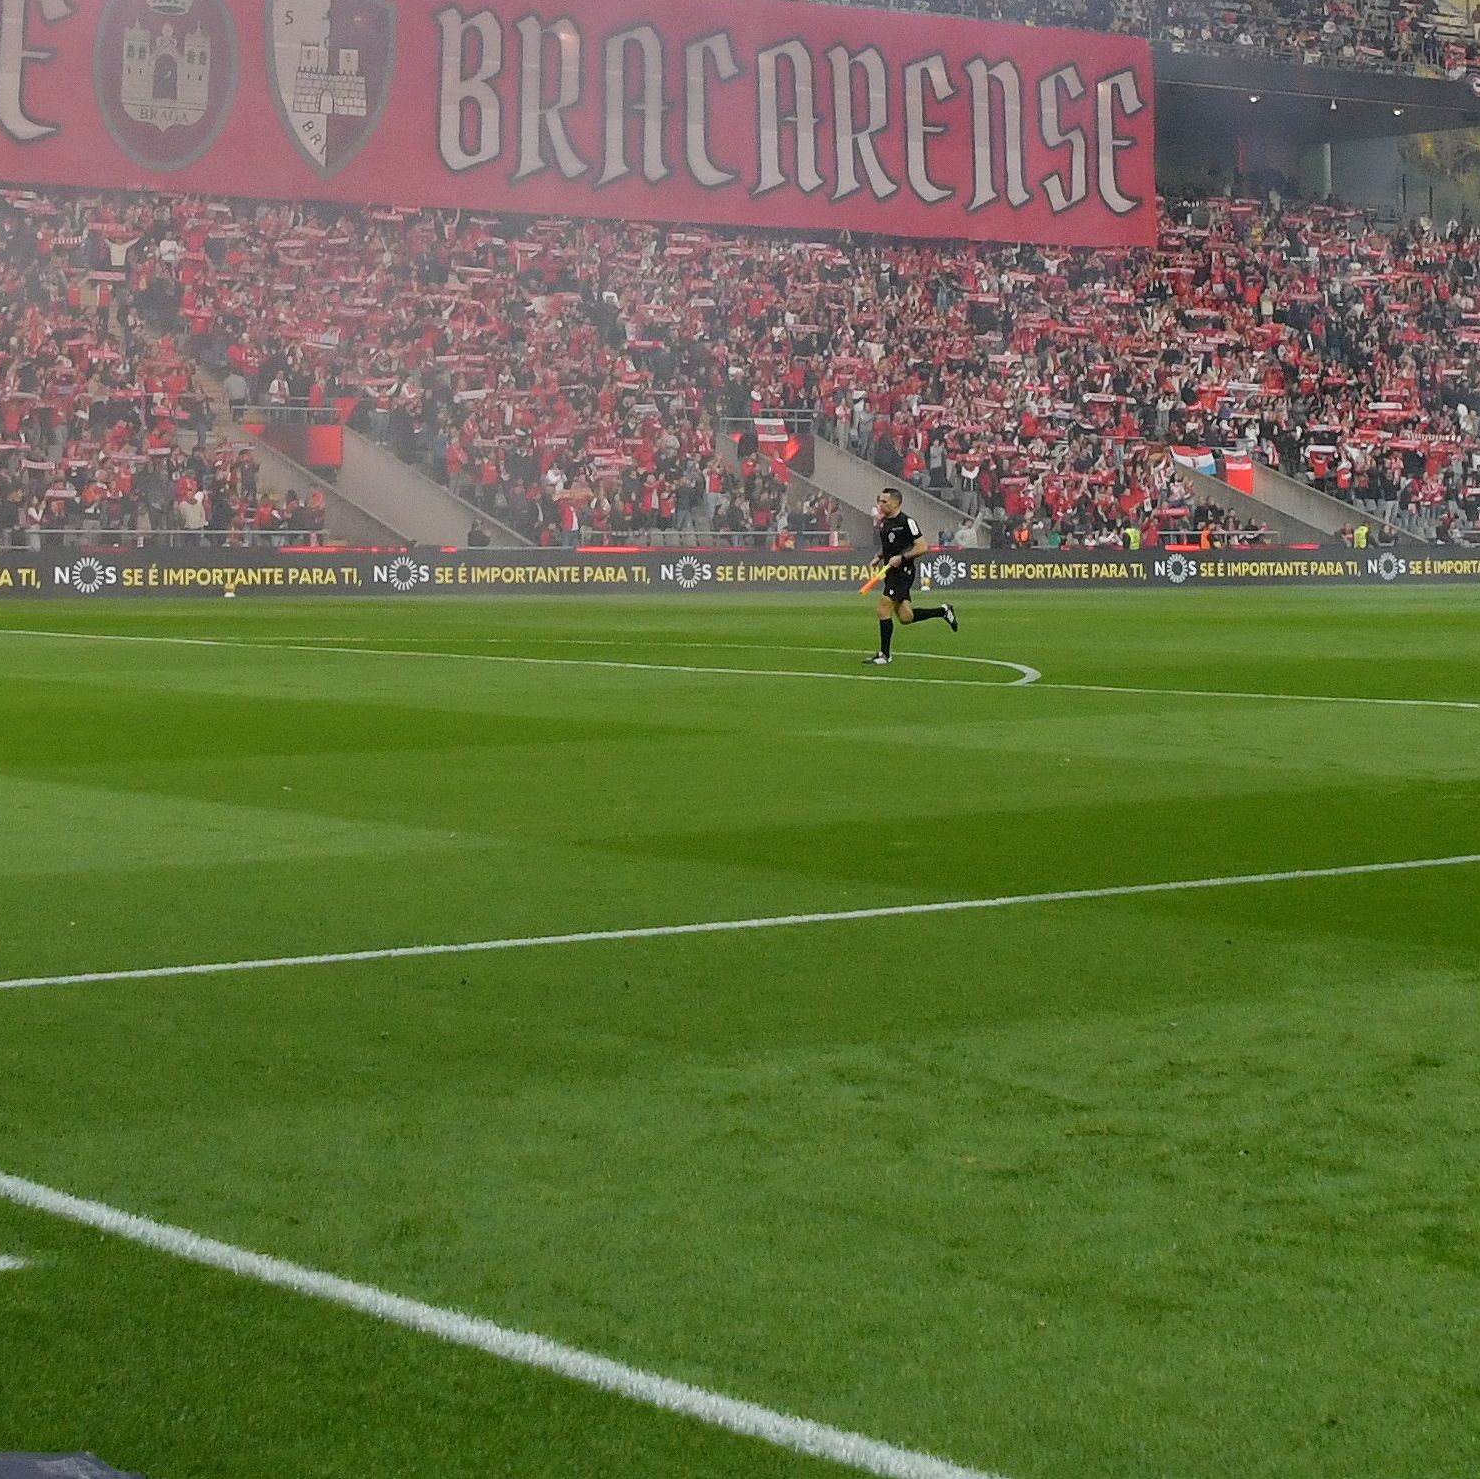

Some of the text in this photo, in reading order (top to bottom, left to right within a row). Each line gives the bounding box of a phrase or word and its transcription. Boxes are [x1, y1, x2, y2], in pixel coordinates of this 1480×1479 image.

[433, 3, 1145, 217] BRACARENSE
[122, 567, 145, 587] SE
[149, 563, 160, 587] É
[163, 567, 283, 586] IMPORTANTE
[288, 567, 337, 585] PARA
[341, 567, 363, 588] TI,
[434, 566, 454, 584] SE
[458, 562, 467, 584] É
[471, 566, 580, 583] IMPORTANTE
[583, 566, 628, 583] PARA
[631, 566, 651, 586] TI,
[716, 565, 734, 582] SE
[737, 561, 746, 582] É
[749, 565, 847, 581] IMPORTANTE
[971, 564, 987, 580] SE
[990, 560, 998, 580] É
[1001, 563, 1088, 579] IMPORTANTE
[1091, 563, 1128, 578] PARA
[1131, 563, 1147, 581] TI,
[1200, 562, 1217, 577] SE
[1219, 558, 1225, 577] É
[1227, 562, 1309, 577] IMPORTANTE
[1311, 562, 1347, 576] PARA
[1350, 562, 1362, 579] TI,
[1409, 561, 1424, 575] SE
[1425, 557, 1433, 575] É
[17, 568, 41, 590] TI,
